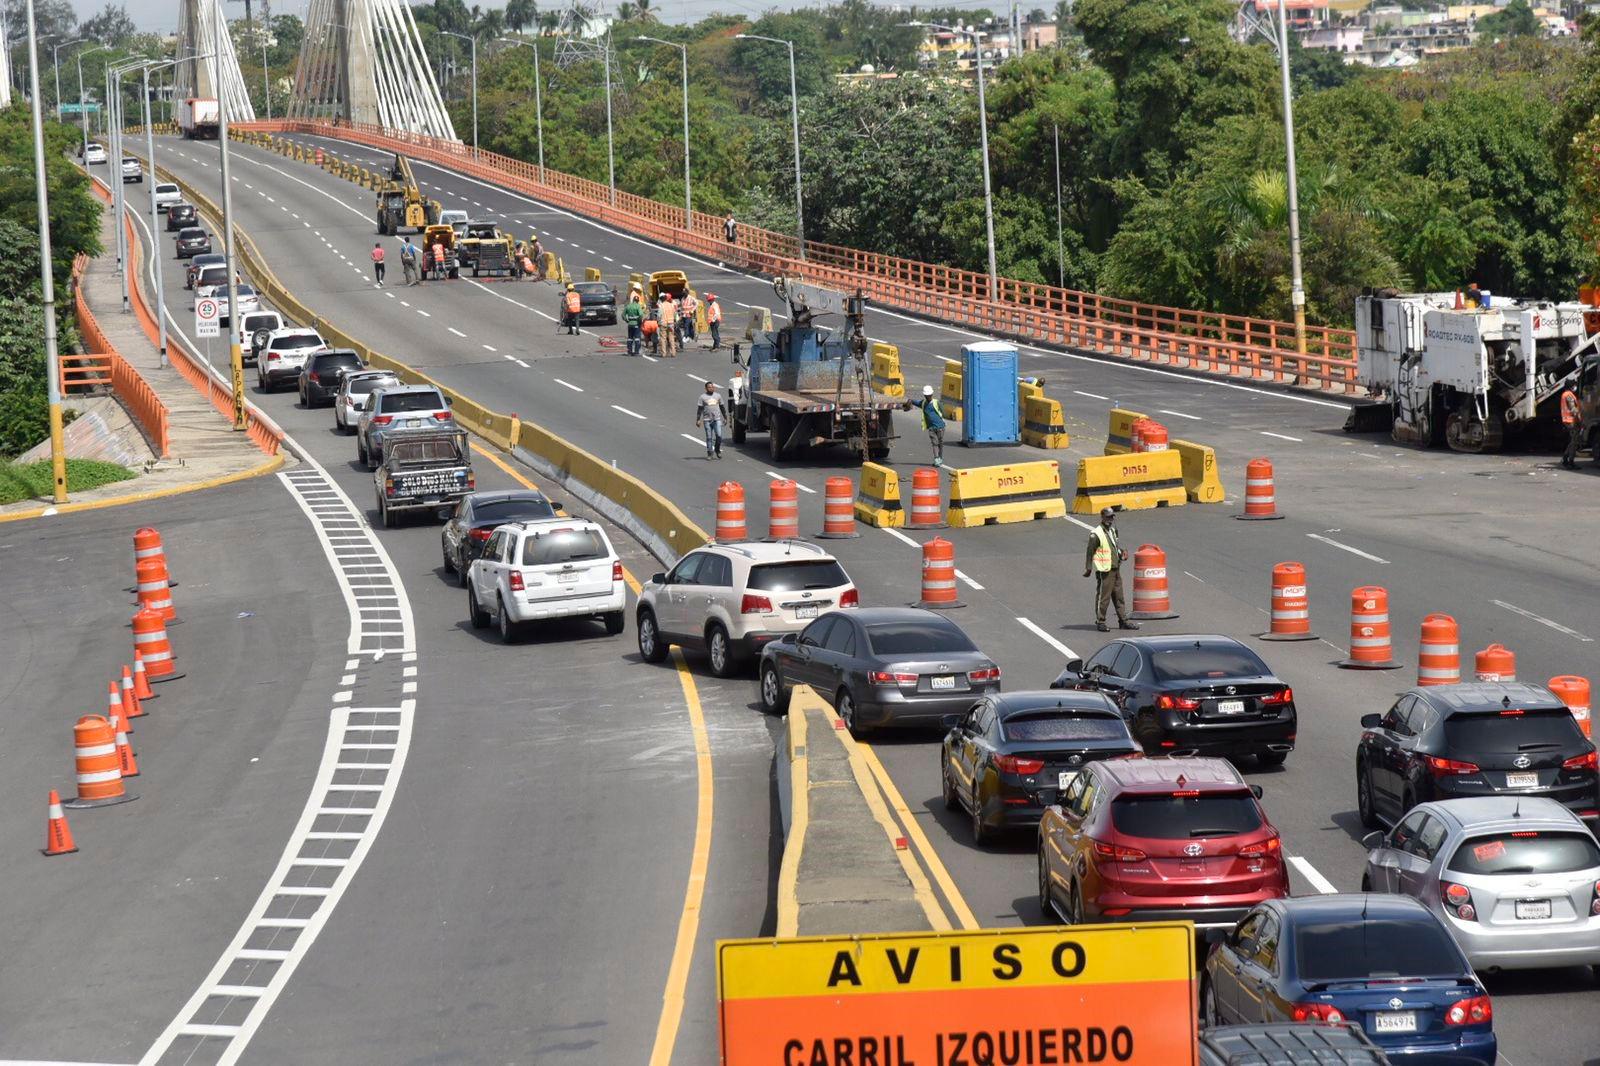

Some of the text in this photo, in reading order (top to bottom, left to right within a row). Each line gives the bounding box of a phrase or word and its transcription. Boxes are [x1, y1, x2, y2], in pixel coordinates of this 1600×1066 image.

[402, 476, 420, 487] SOLO
[827, 941, 1087, 987] AVISO
[783, 1026, 1134, 1066] CARRIL IZQUIERDO
